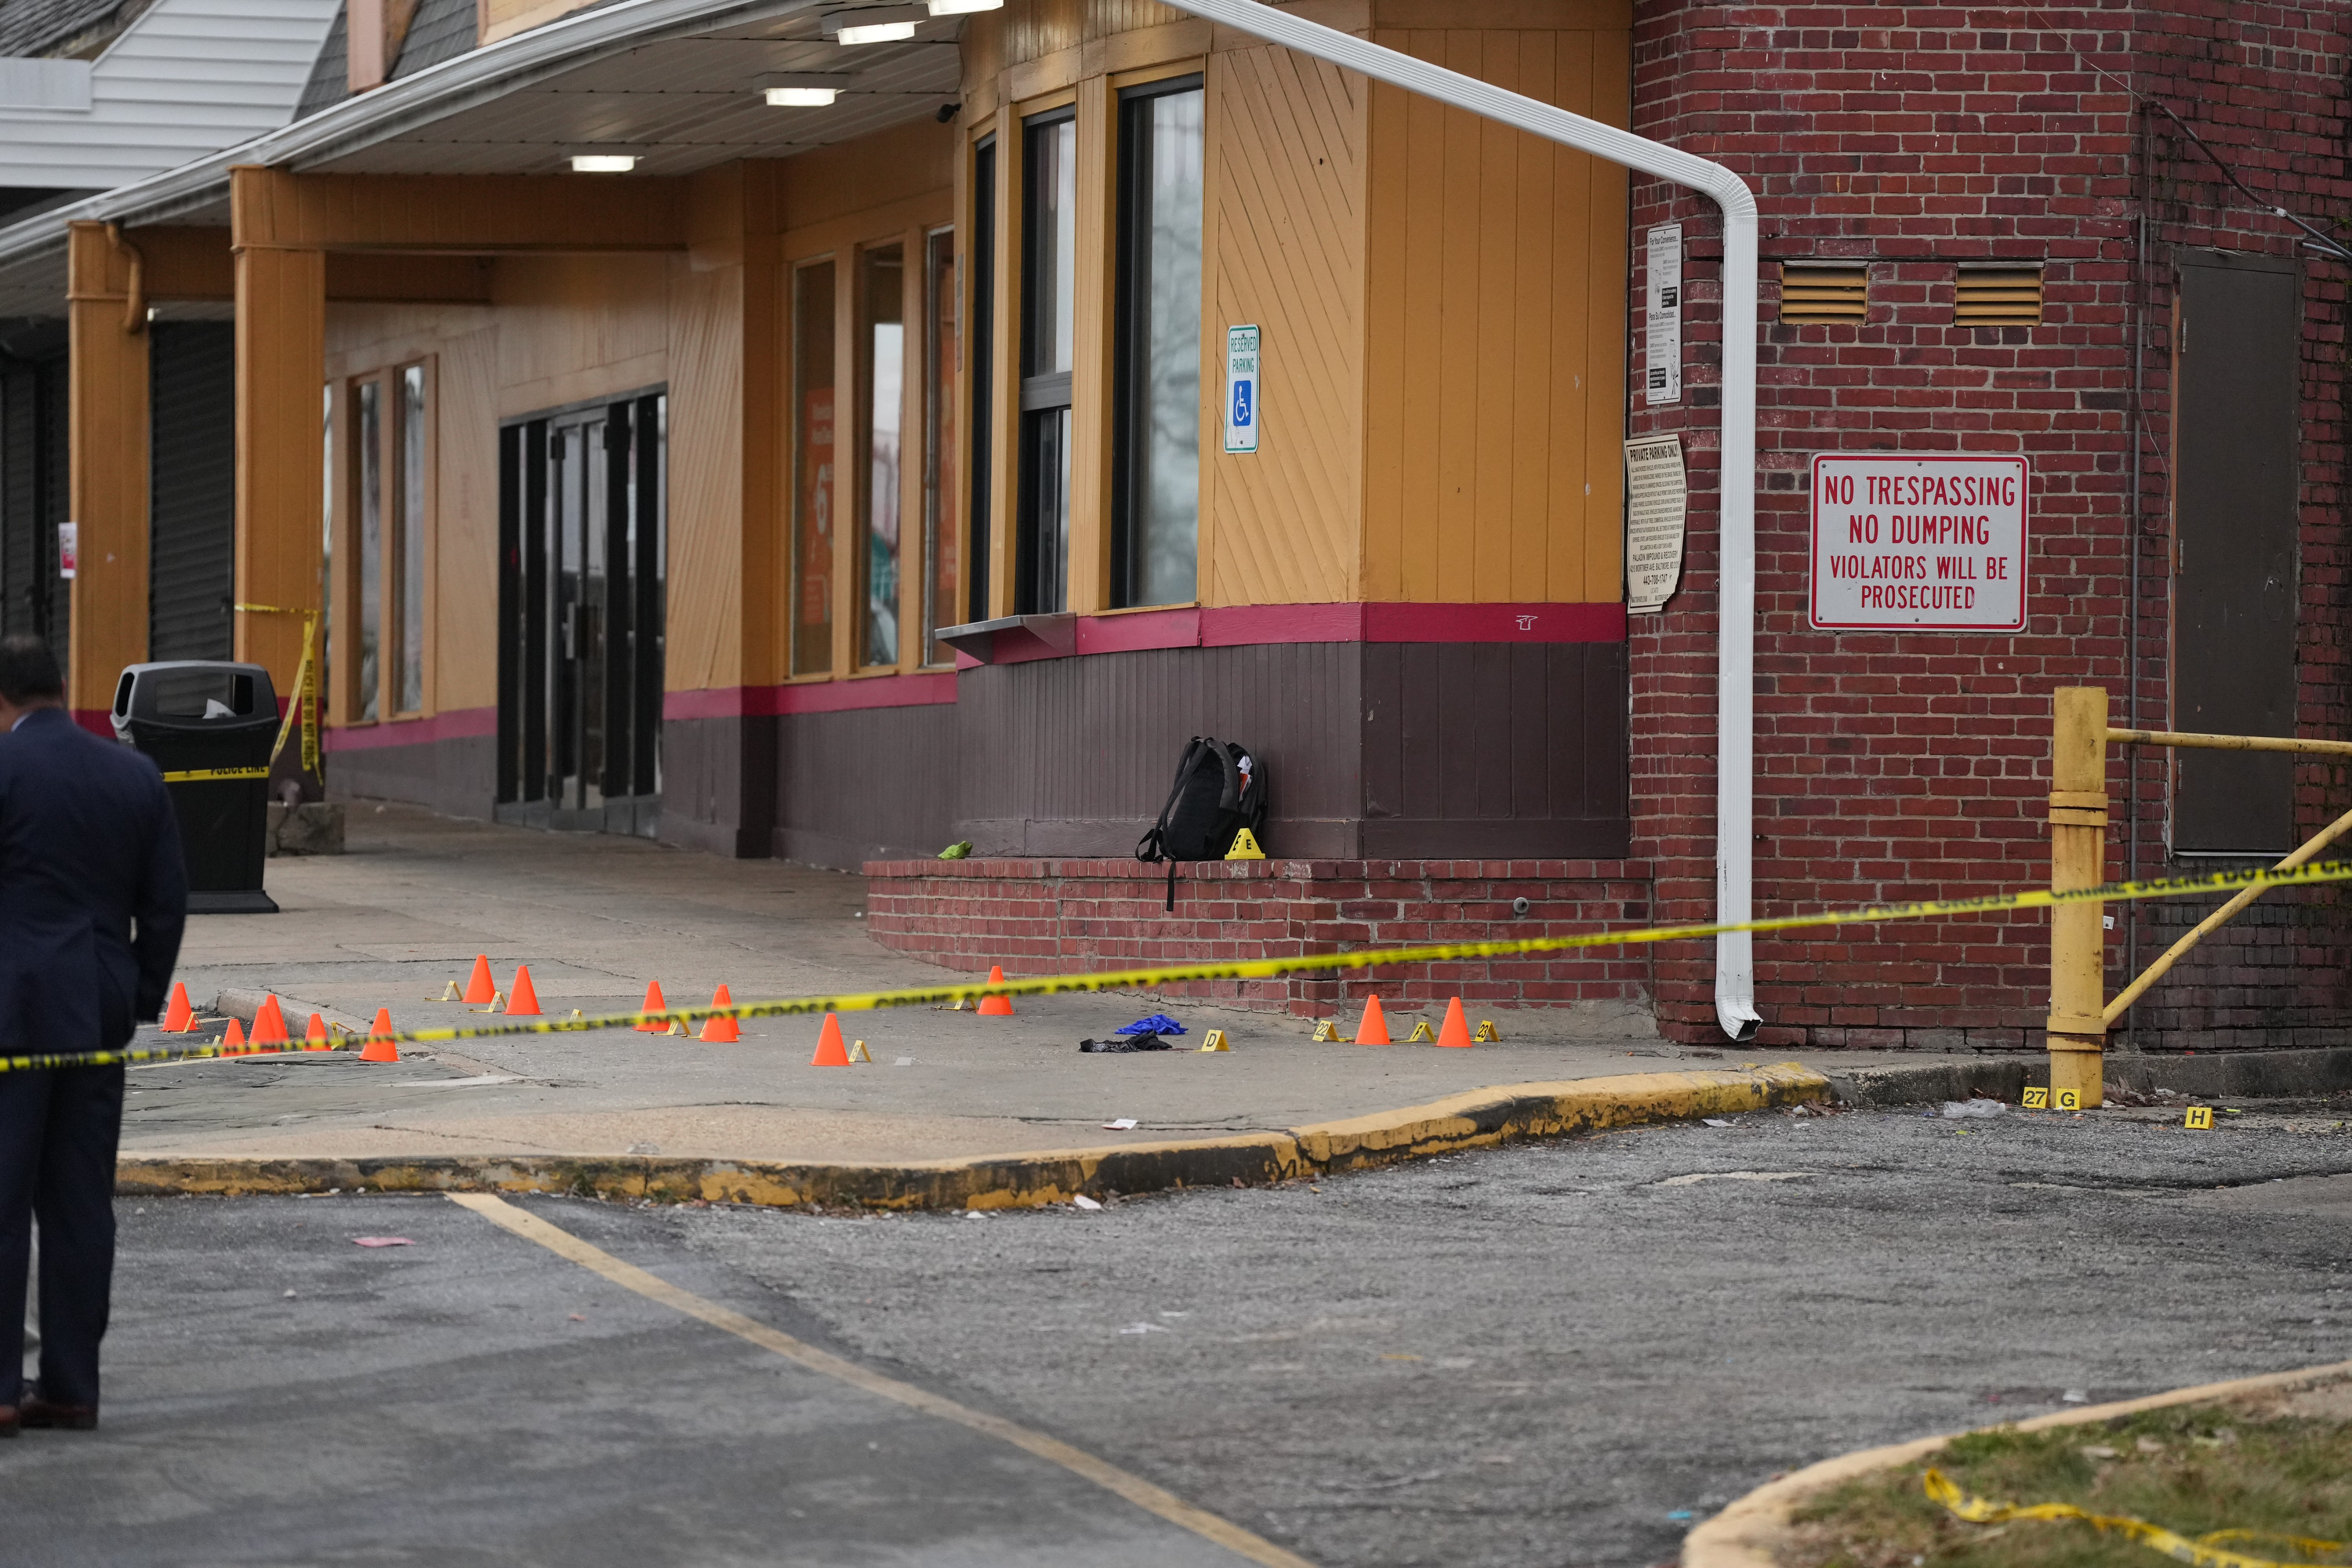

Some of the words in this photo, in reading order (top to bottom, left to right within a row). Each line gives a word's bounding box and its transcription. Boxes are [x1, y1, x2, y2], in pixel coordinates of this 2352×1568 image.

[1231, 336, 1257, 353] RESERVED
[1232, 358, 1254, 373] PARKING
[1629, 448, 1649, 463] PRIVATE
[1649, 445, 1668, 461] PARKING
[1825, 475, 1854, 505] NO
[1866, 475, 2016, 506] TRESPASSING
[1849, 514, 1878, 544] NO
[1892, 515, 1990, 545] DUMPING
[1830, 555, 1926, 579] VIOLATORS
[1936, 556, 1977, 580] WILL
[1986, 557, 2008, 580] BE
[1861, 585, 1976, 609] PROSECUTED
[1246, 839, 1251, 850] E
[1315, 1022, 1329, 1037] 22
[1476, 1024, 1490, 1039] 23
[1207, 1033, 1217, 1047] D
[2024, 1090, 2046, 1105] 27
[2060, 1091, 2075, 1107] G
[2190, 1109, 2205, 1125] H
